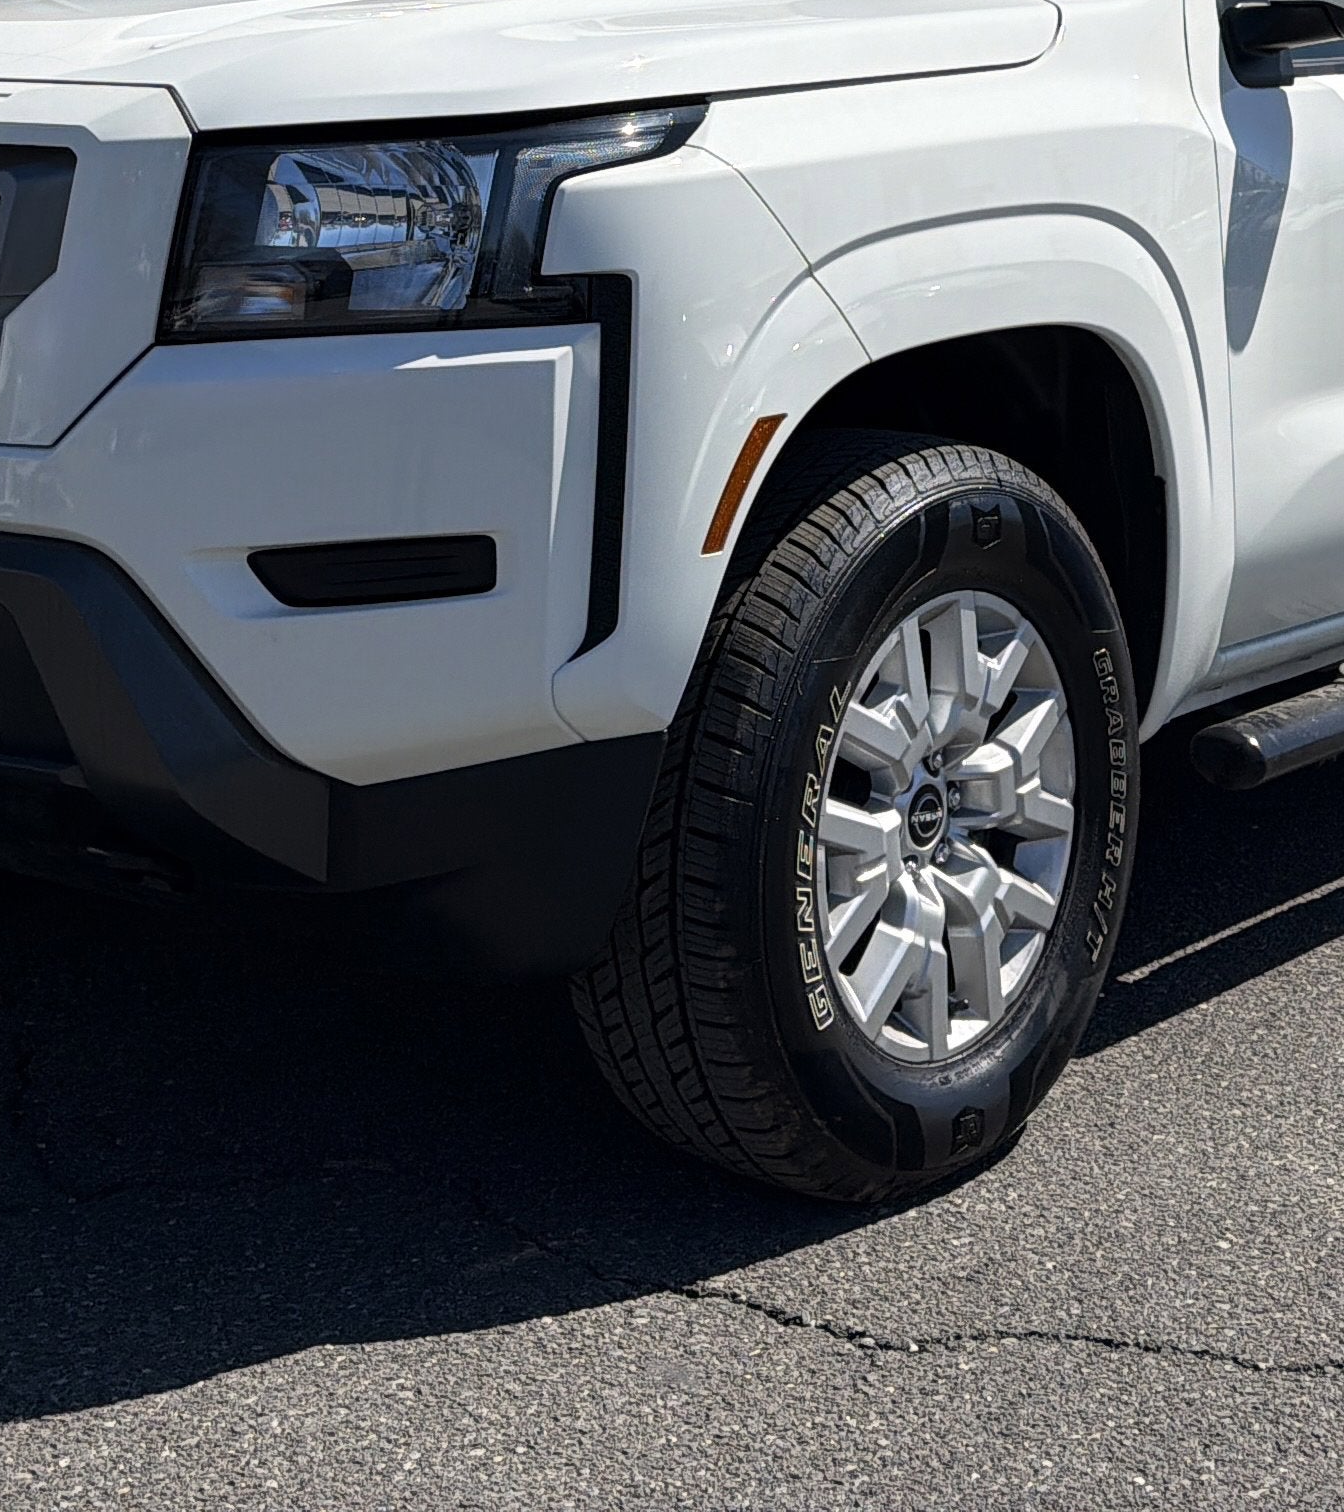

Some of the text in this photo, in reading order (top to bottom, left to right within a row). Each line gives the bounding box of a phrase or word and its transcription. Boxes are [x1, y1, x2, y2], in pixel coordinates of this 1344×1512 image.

[795, 680, 852, 1031] GENERAL
[1086, 647, 1127, 963] GRABBER H/T
